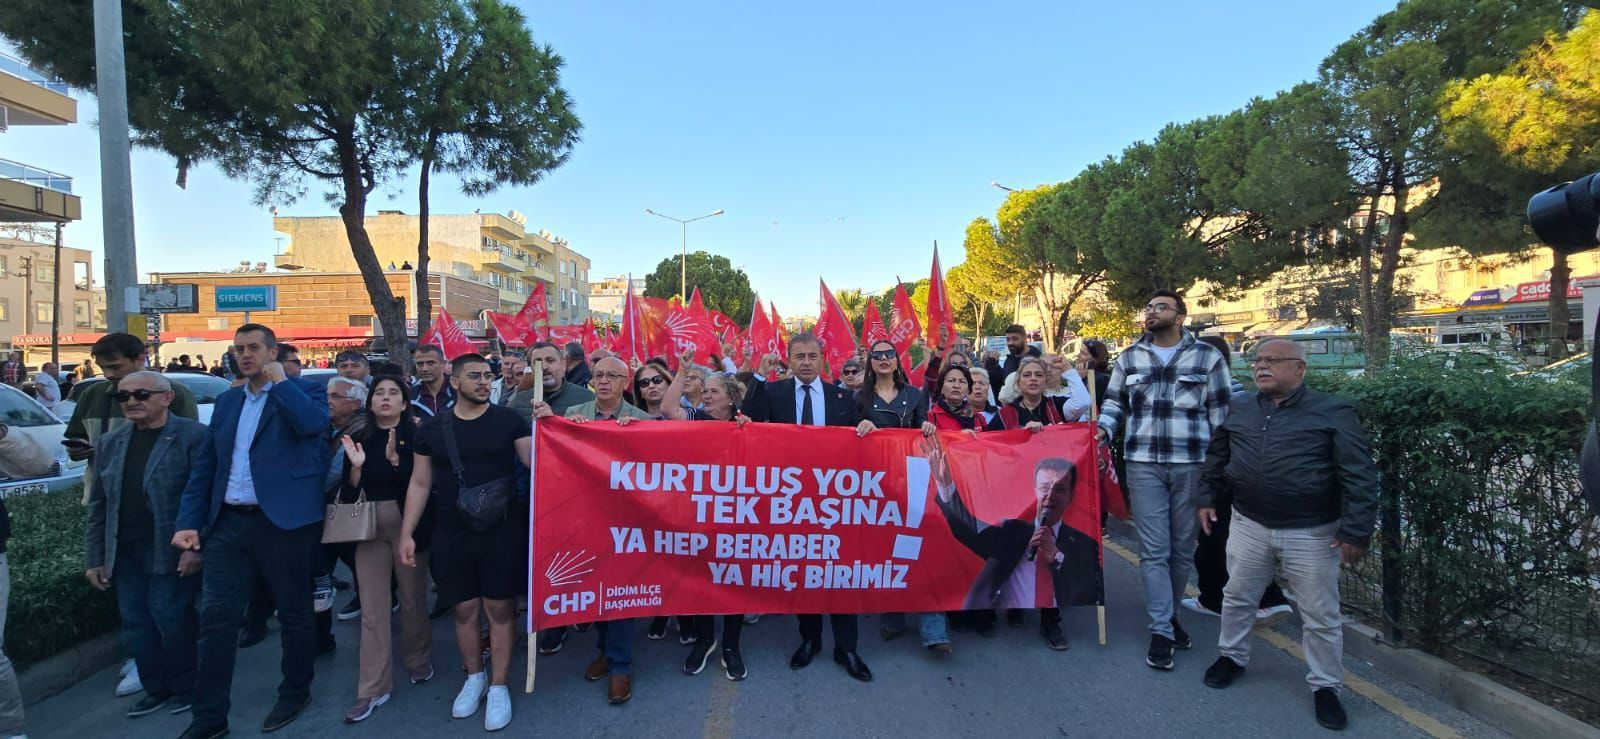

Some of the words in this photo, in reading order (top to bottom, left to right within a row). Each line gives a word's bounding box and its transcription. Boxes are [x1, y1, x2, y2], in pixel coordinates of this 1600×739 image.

[218, 293, 264, 302] SIEMENS
[609, 461, 803, 499] KURTULUŞ
[812, 468, 886, 498] YOK
[691, 494, 760, 524] TEK
[770, 496, 903, 530] BAŞINA
[610, 527, 647, 554] YA
[654, 530, 709, 556] HEP
[716, 533, 841, 560] BERABER
[708, 562, 744, 586] YA
[751, 560, 799, 591] HİÇ
[804, 560, 909, 589] BİRİMİZ
[543, 591, 596, 615] CHP
[605, 597, 662, 610] BAŞKANLIĞI
[606, 584, 638, 597] DİDİM
[640, 584, 661, 596] İLÇE
